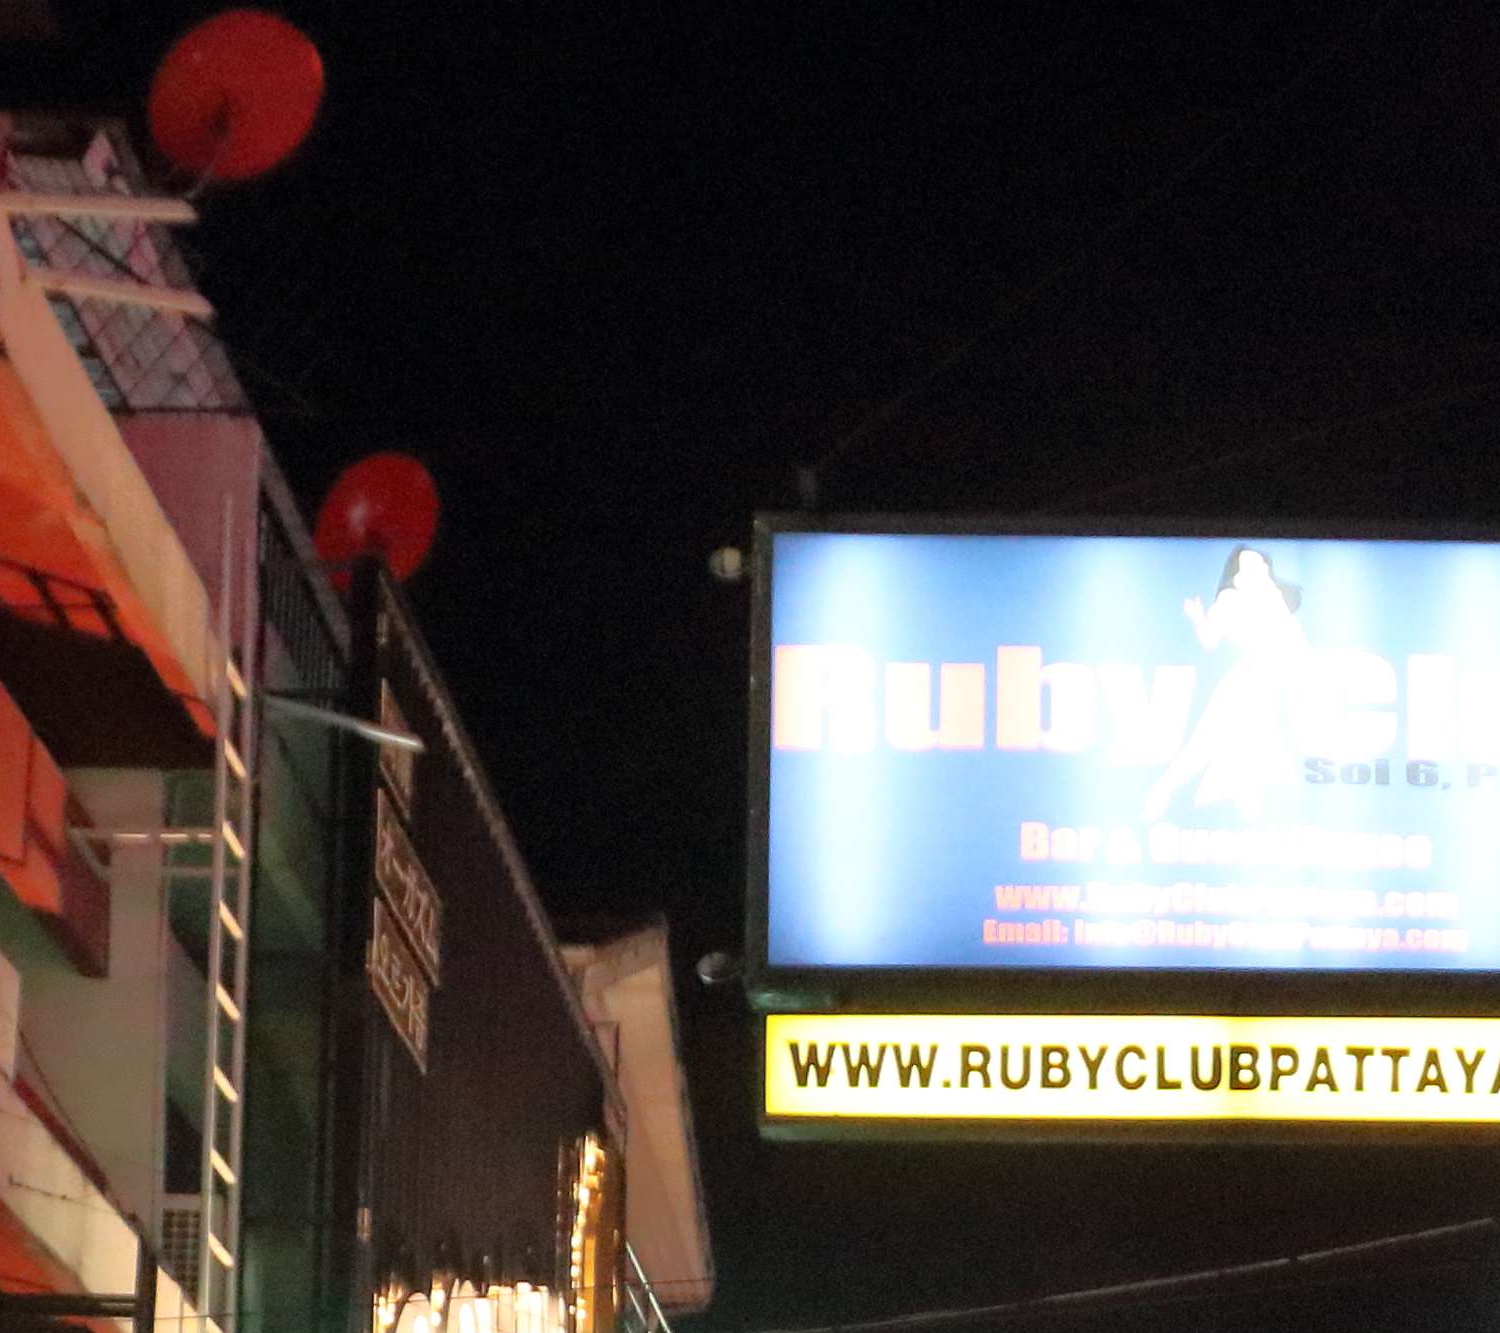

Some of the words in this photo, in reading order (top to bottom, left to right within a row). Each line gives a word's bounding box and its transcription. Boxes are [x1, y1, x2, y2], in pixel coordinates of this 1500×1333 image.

[775, 644, 1195, 766] Ruby
[1303, 756, 1392, 788] Soi
[1406, 758, 1452, 792] 6,
[1020, 821, 1099, 862] Bar
